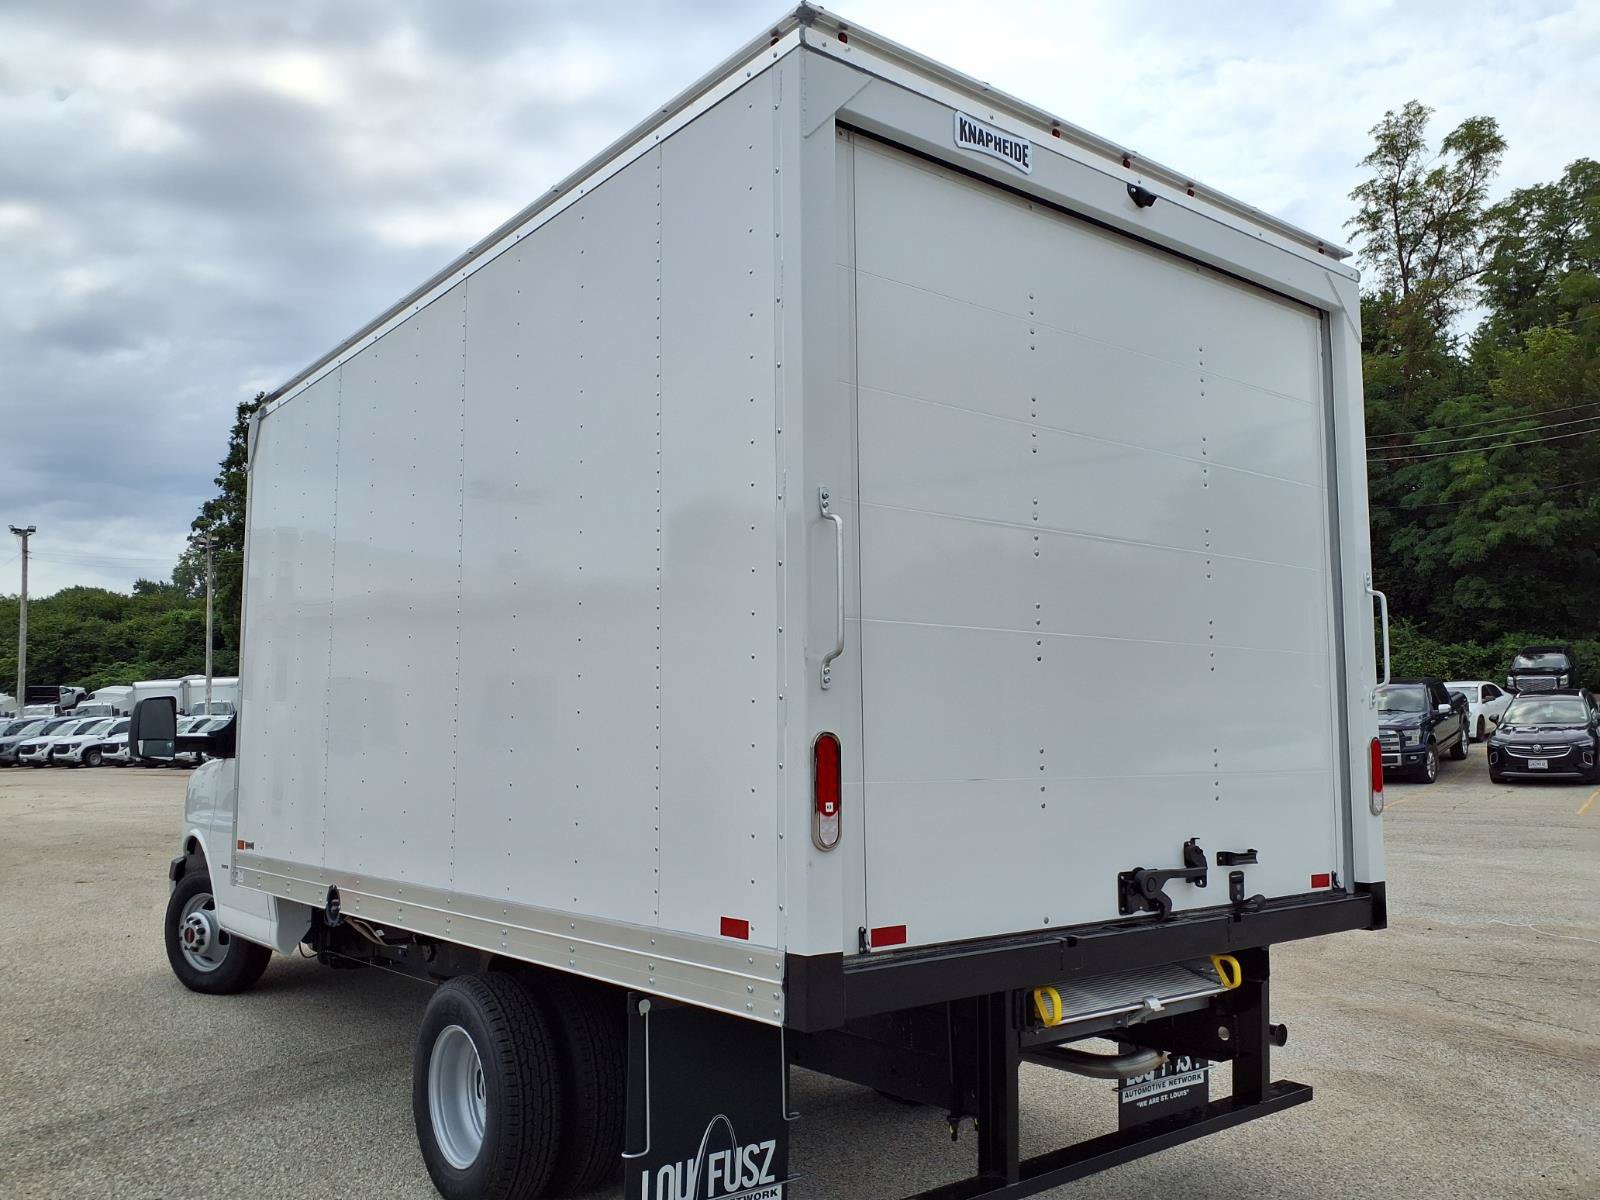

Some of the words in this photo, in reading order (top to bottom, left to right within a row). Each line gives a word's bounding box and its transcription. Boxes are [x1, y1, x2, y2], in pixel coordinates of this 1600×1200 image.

[959, 116, 1029, 169] KNAPHEIDE
[1124, 1081, 1166, 1099] AUTOMOTIVE
[1168, 1073, 1202, 1087] NETWORK
[1148, 1096, 1160, 1105] ARE
[641, 1158, 697, 1200] LOU
[707, 1139, 777, 1198] FUSZ
